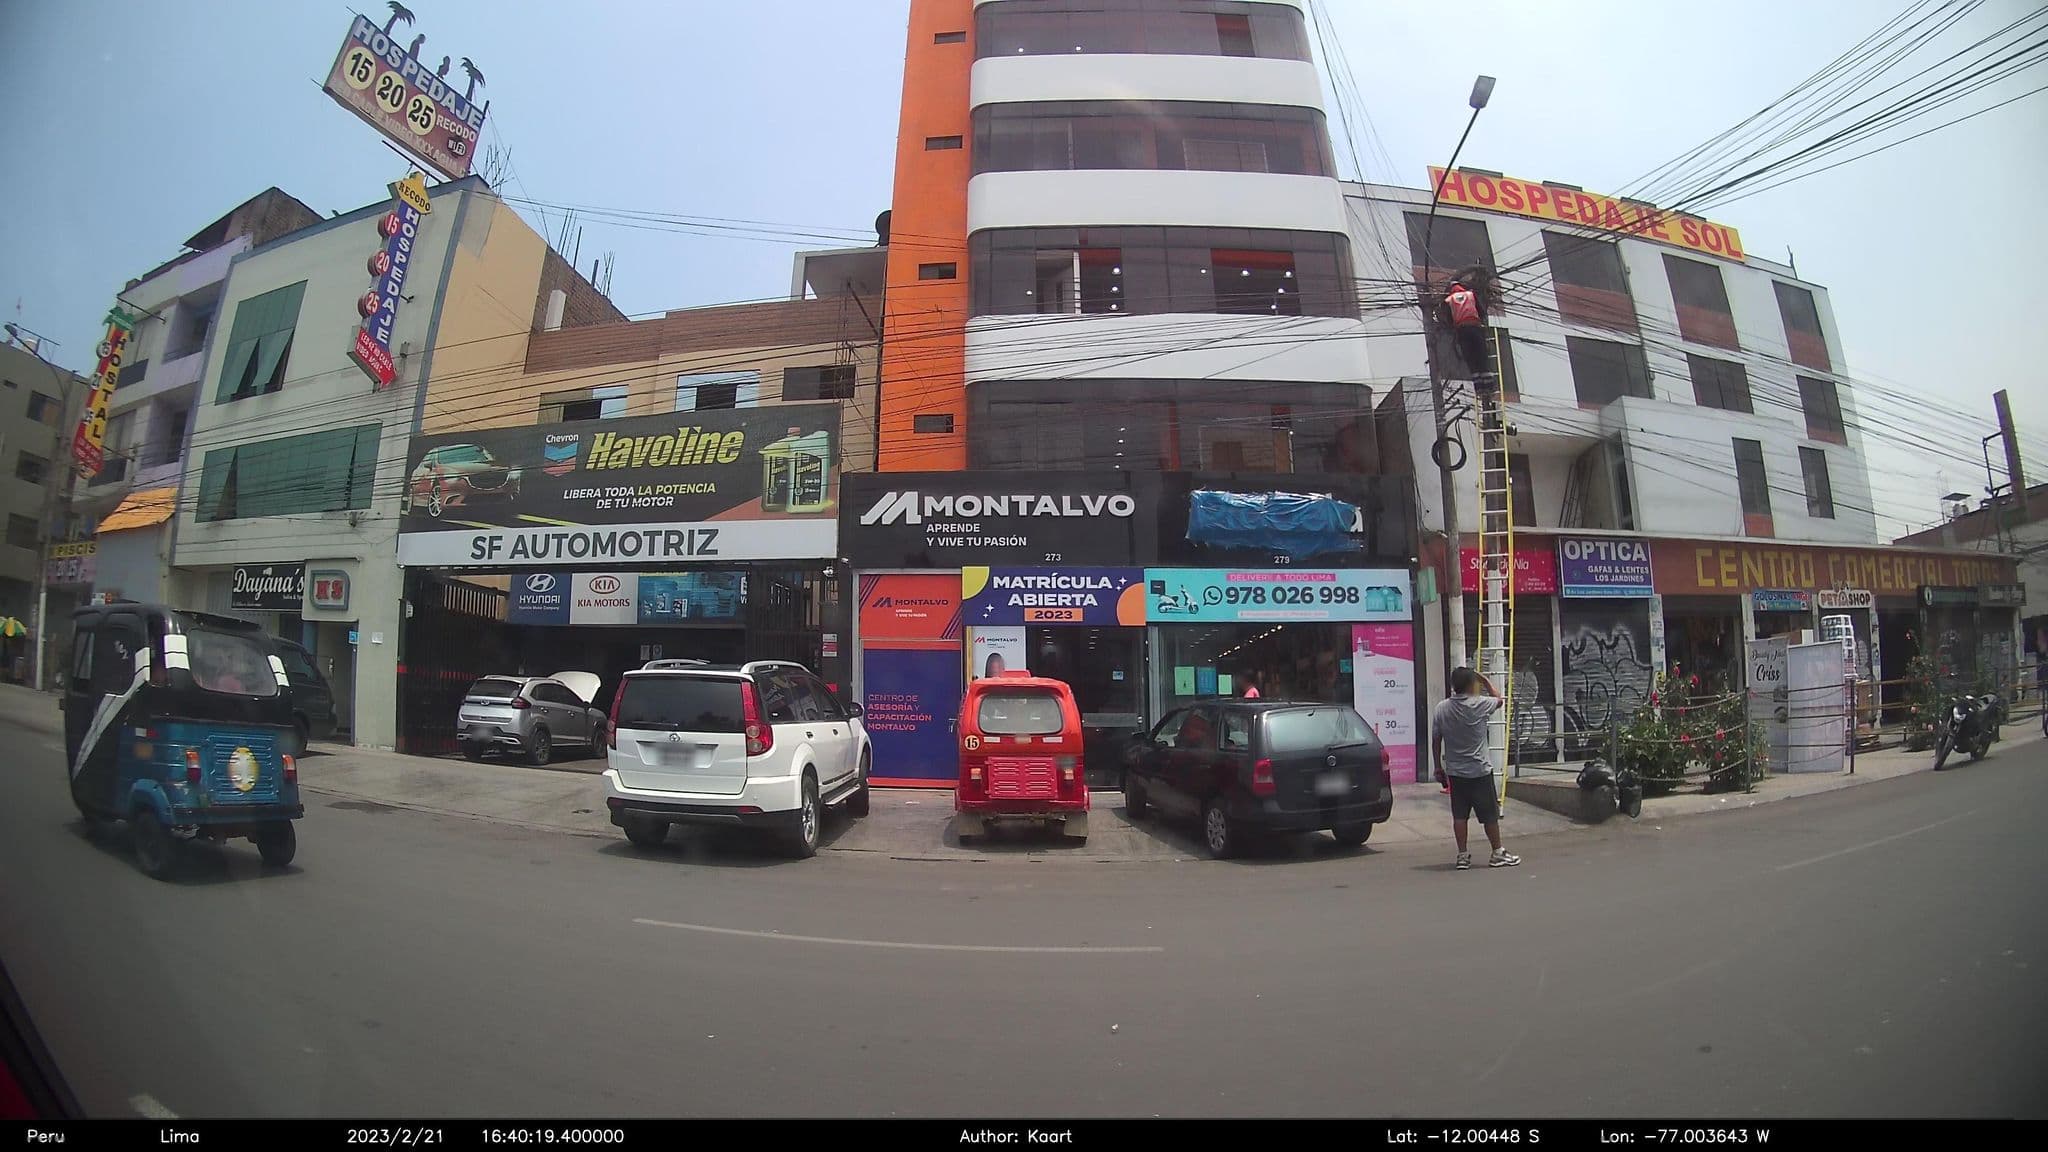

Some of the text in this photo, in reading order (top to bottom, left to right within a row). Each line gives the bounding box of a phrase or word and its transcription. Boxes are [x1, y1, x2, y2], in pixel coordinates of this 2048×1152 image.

[352, 17, 485, 132] HOSPEDAJE
[350, 52, 374, 83] 15
[376, 76, 405, 108] 20
[408, 98, 434, 130] 25
[436, 114, 477, 143] RECODO
[398, 182, 432, 213] RECODO
[1433, 169, 1743, 258] HOSPEDAJE SOL
[386, 213, 399, 234] 15
[377, 252, 390, 273] 20
[376, 207, 421, 345] HOSPEDAJE
[365, 292, 379, 314] 25
[92, 337, 127, 440] HOSTAL
[545, 434, 579, 443] Chevron
[586, 427, 745, 470] Havoline
[563, 482, 717, 499] LIBERA TODA LA POTENCIA
[596, 496, 674, 509] DE TU MOTOR
[924, 494, 1136, 518] MONTALVO
[926, 523, 981, 533] APRENDE
[471, 528, 720, 560] SF AUTOMOTRIZ
[926, 534, 1027, 546] Y VIVE TU PASIÓN
[1045, 553, 1062, 562] 273
[1564, 540, 1648, 562] OPTICA
[1274, 556, 1290, 564] 279
[1588, 565, 1649, 575] GAFAS & LENTES
[1695, 548, 1816, 588] CENTRO
[1827, 553, 1946, 590] COMERCIAL
[993, 572, 1113, 589] MATRÍCULA
[1275, 574, 1283, 582] A
[1284, 574, 1310, 582] TODO
[1312, 574, 1333, 582] LIMA
[1595, 574, 1645, 583] LOS JARDINES
[594, 580, 615, 590] KIA
[519, 595, 561, 604] HYUNDAI
[1007, 593, 1098, 606] ABIERTA
[1226, 586, 1360, 605] 978 026 998
[1820, 593, 1838, 606] PET
[1848, 593, 1871, 606] SHOP
[577, 599, 630, 608] KIA MOTORS
[1034, 610, 1074, 620] 2023
[1756, 663, 1780, 682] Criss
[1383, 679, 1396, 688] 20
[905, 694, 919, 702] DE
[868, 702, 913, 711] ASESORÍA
[867, 713, 932, 721] CAPACITACIÓN
[867, 723, 916, 731] MONTALVO
[1385, 720, 1397, 729] 30
[965, 737, 979, 748] 15
